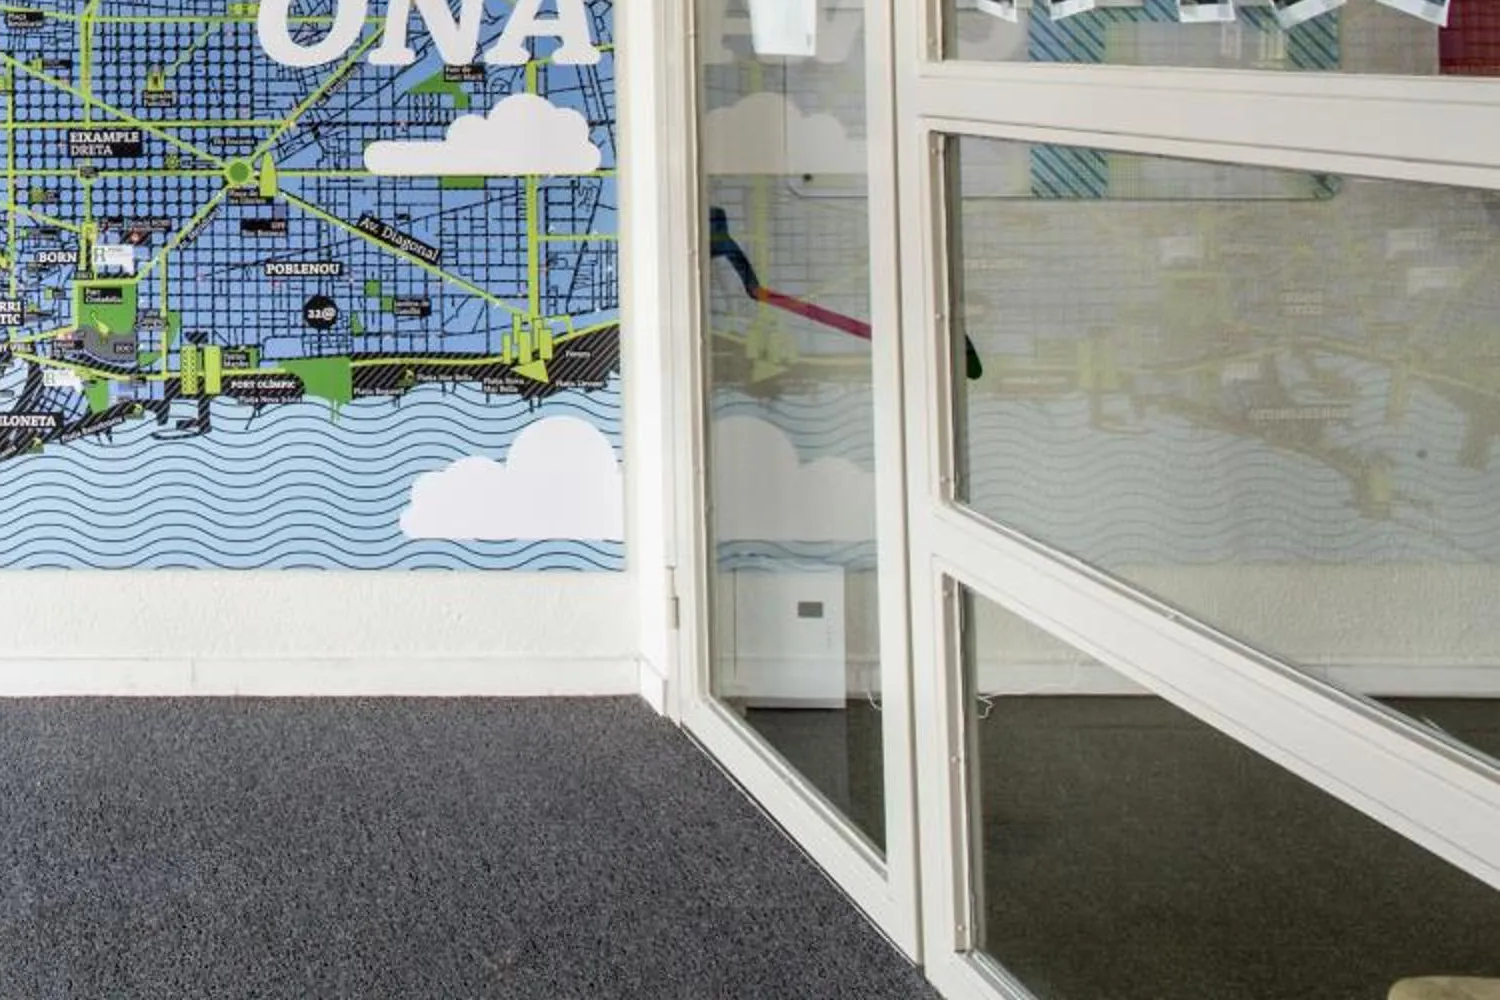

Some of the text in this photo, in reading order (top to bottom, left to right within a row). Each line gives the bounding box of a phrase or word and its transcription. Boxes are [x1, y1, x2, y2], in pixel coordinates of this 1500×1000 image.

[69, 131, 139, 143] EIXAMPLE
[70, 144, 113, 156] DRETA
[360, 218, 440, 261] Av. Diagonal
[38, 251, 77, 263] BORN
[265, 263, 340, 275] POBLENOU
[307, 306, 337, 321] 22@
[231, 380, 255, 389] PORT
